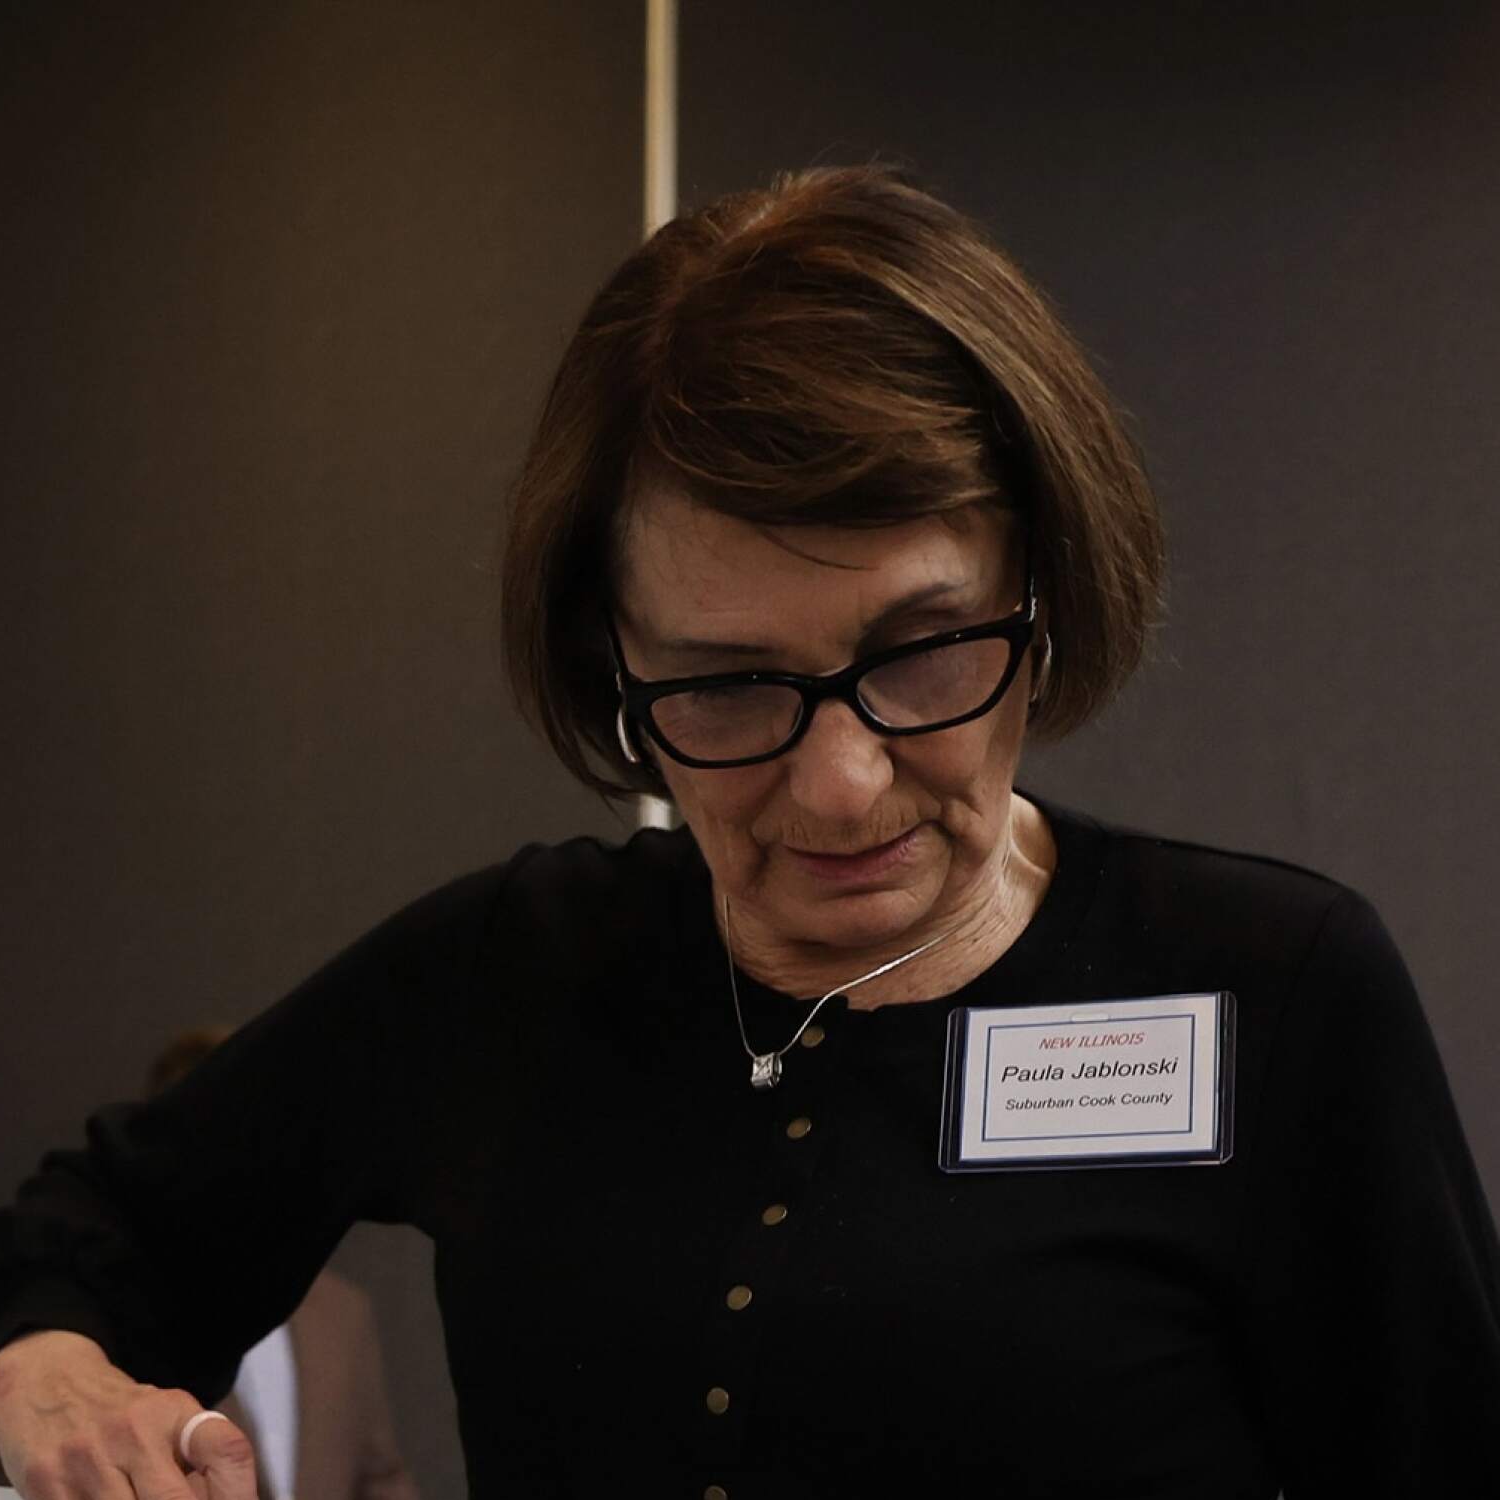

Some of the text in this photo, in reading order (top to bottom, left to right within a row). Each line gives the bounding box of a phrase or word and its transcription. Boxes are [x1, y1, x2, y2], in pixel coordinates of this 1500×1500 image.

[1039, 1032, 1145, 1050] NEW ILLINOIS
[1001, 1057, 1179, 1083] Paula Jablonski
[1004, 1092, 1173, 1110] Suburban Cook County
